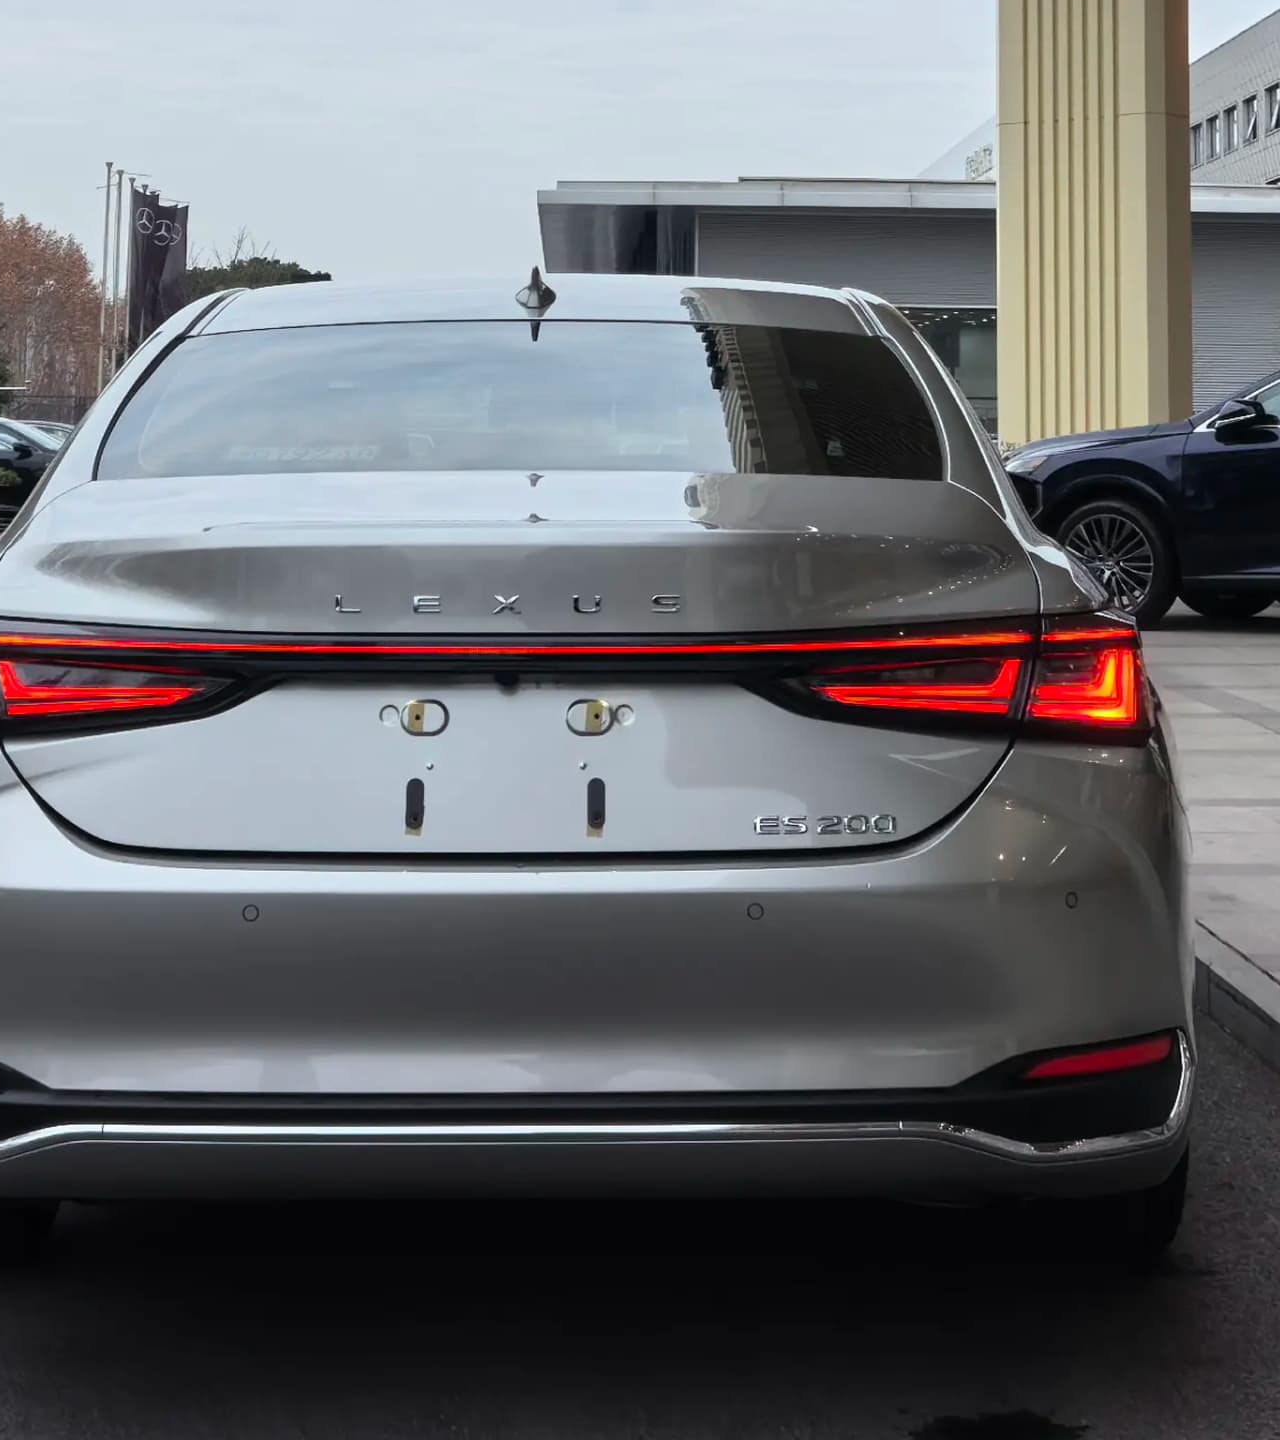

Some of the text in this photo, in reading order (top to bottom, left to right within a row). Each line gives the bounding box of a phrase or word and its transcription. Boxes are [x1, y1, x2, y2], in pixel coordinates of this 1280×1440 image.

[335, 594, 681, 615] LEXUS
[753, 814, 897, 835] ES 200
